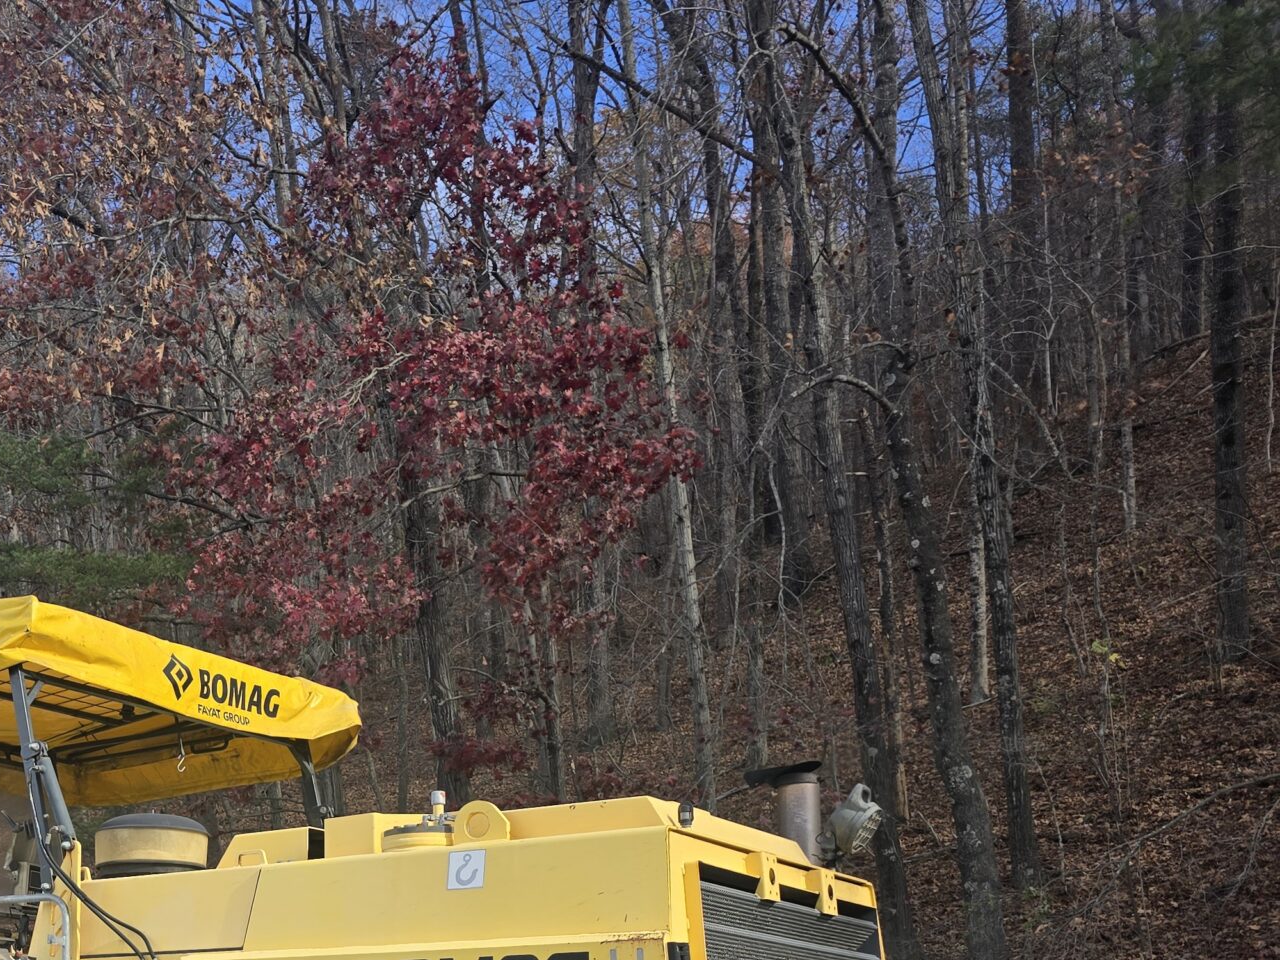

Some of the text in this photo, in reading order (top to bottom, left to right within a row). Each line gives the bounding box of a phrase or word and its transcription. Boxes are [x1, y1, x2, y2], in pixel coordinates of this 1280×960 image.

[198, 668, 280, 718] BOMAG
[197, 704, 250, 726] FAYAT GROUP
